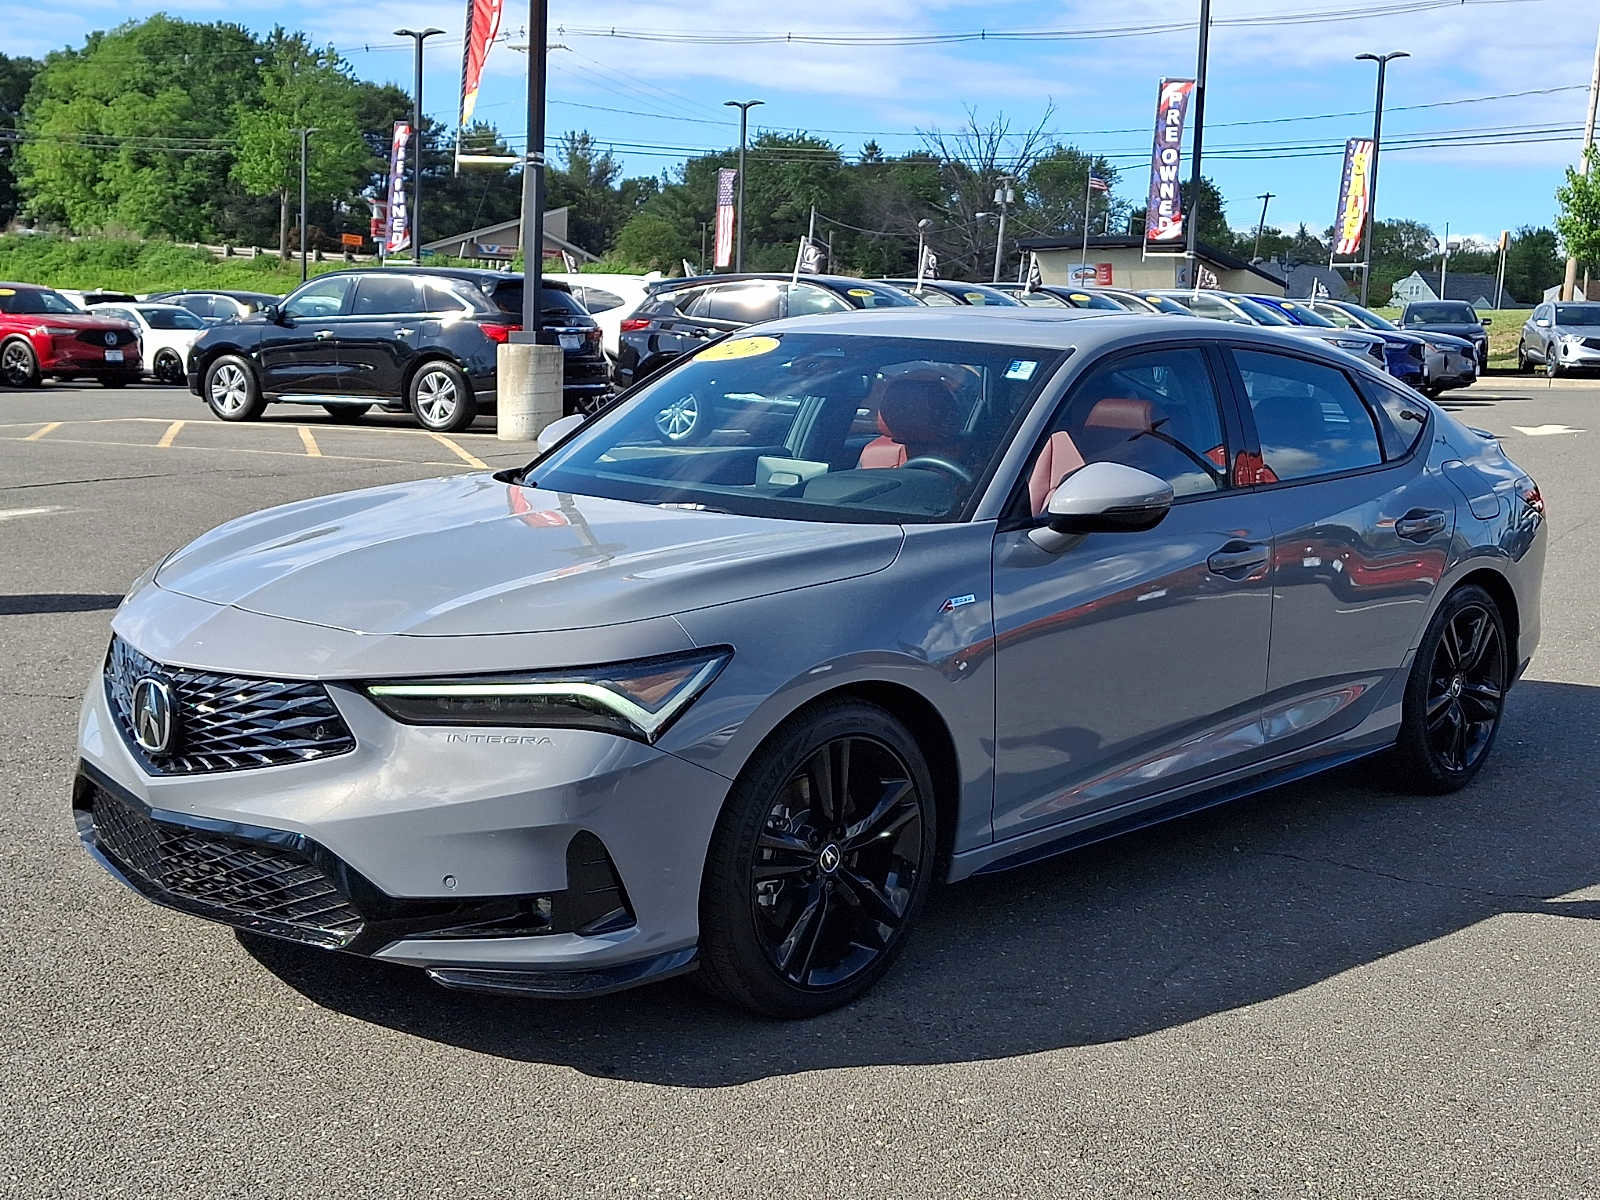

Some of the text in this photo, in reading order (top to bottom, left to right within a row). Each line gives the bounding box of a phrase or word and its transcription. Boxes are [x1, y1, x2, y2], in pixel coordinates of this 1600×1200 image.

[1158, 91, 1184, 231] PRE OWNED
[446, 733, 553, 745] INTEGRA
